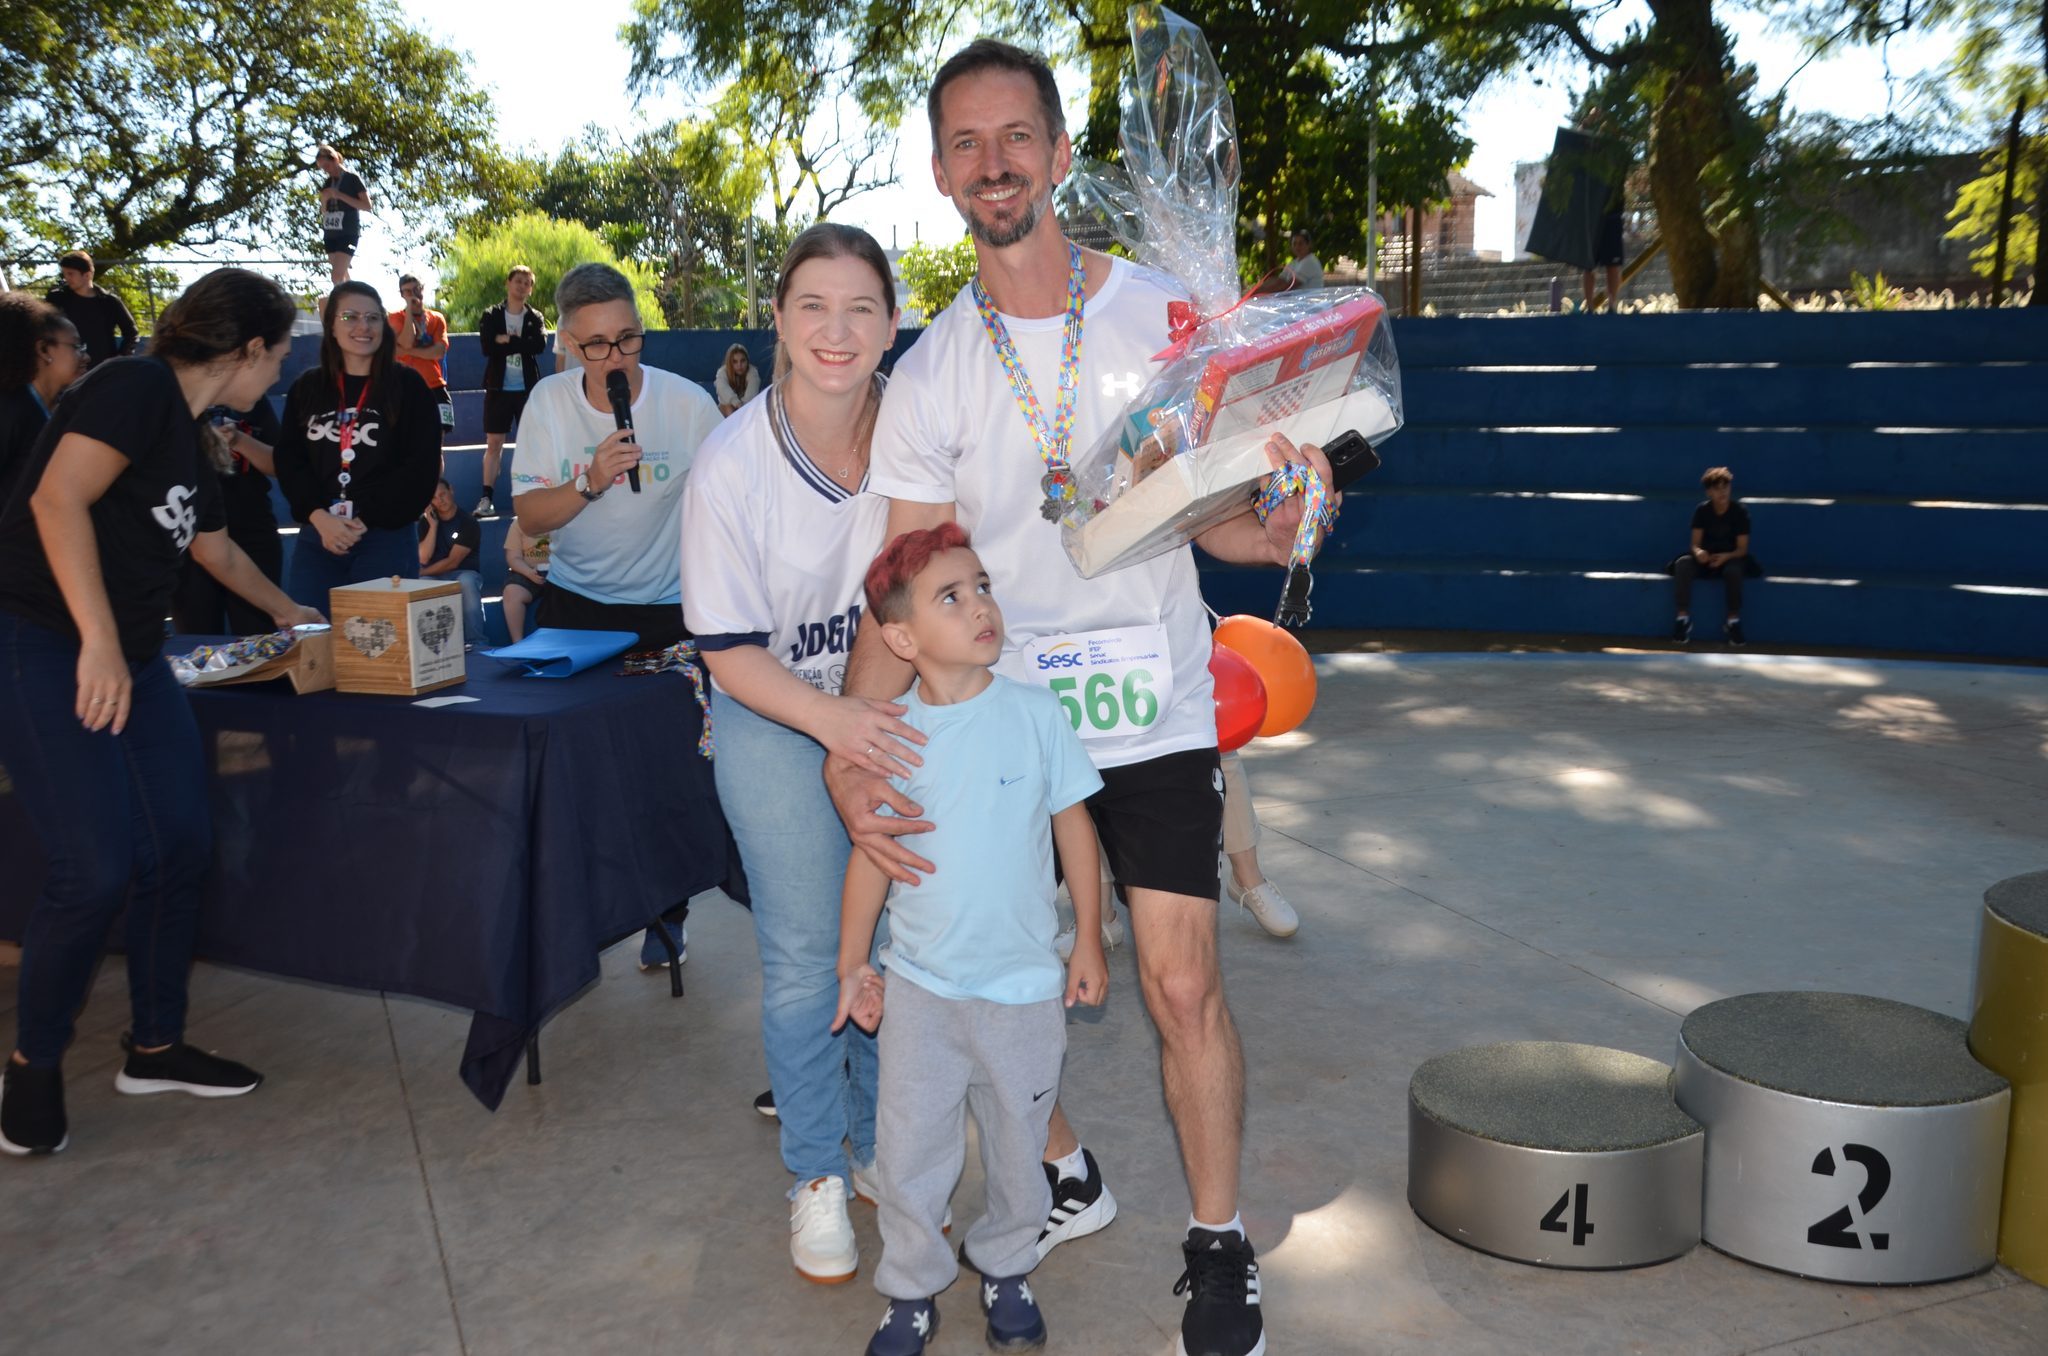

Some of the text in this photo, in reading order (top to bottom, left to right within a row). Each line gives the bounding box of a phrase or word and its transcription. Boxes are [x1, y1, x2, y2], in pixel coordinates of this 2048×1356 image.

[1049, 668, 1158, 735] 566
[1539, 1183, 1594, 1247] 4
[1806, 1143, 1891, 1250] 2
